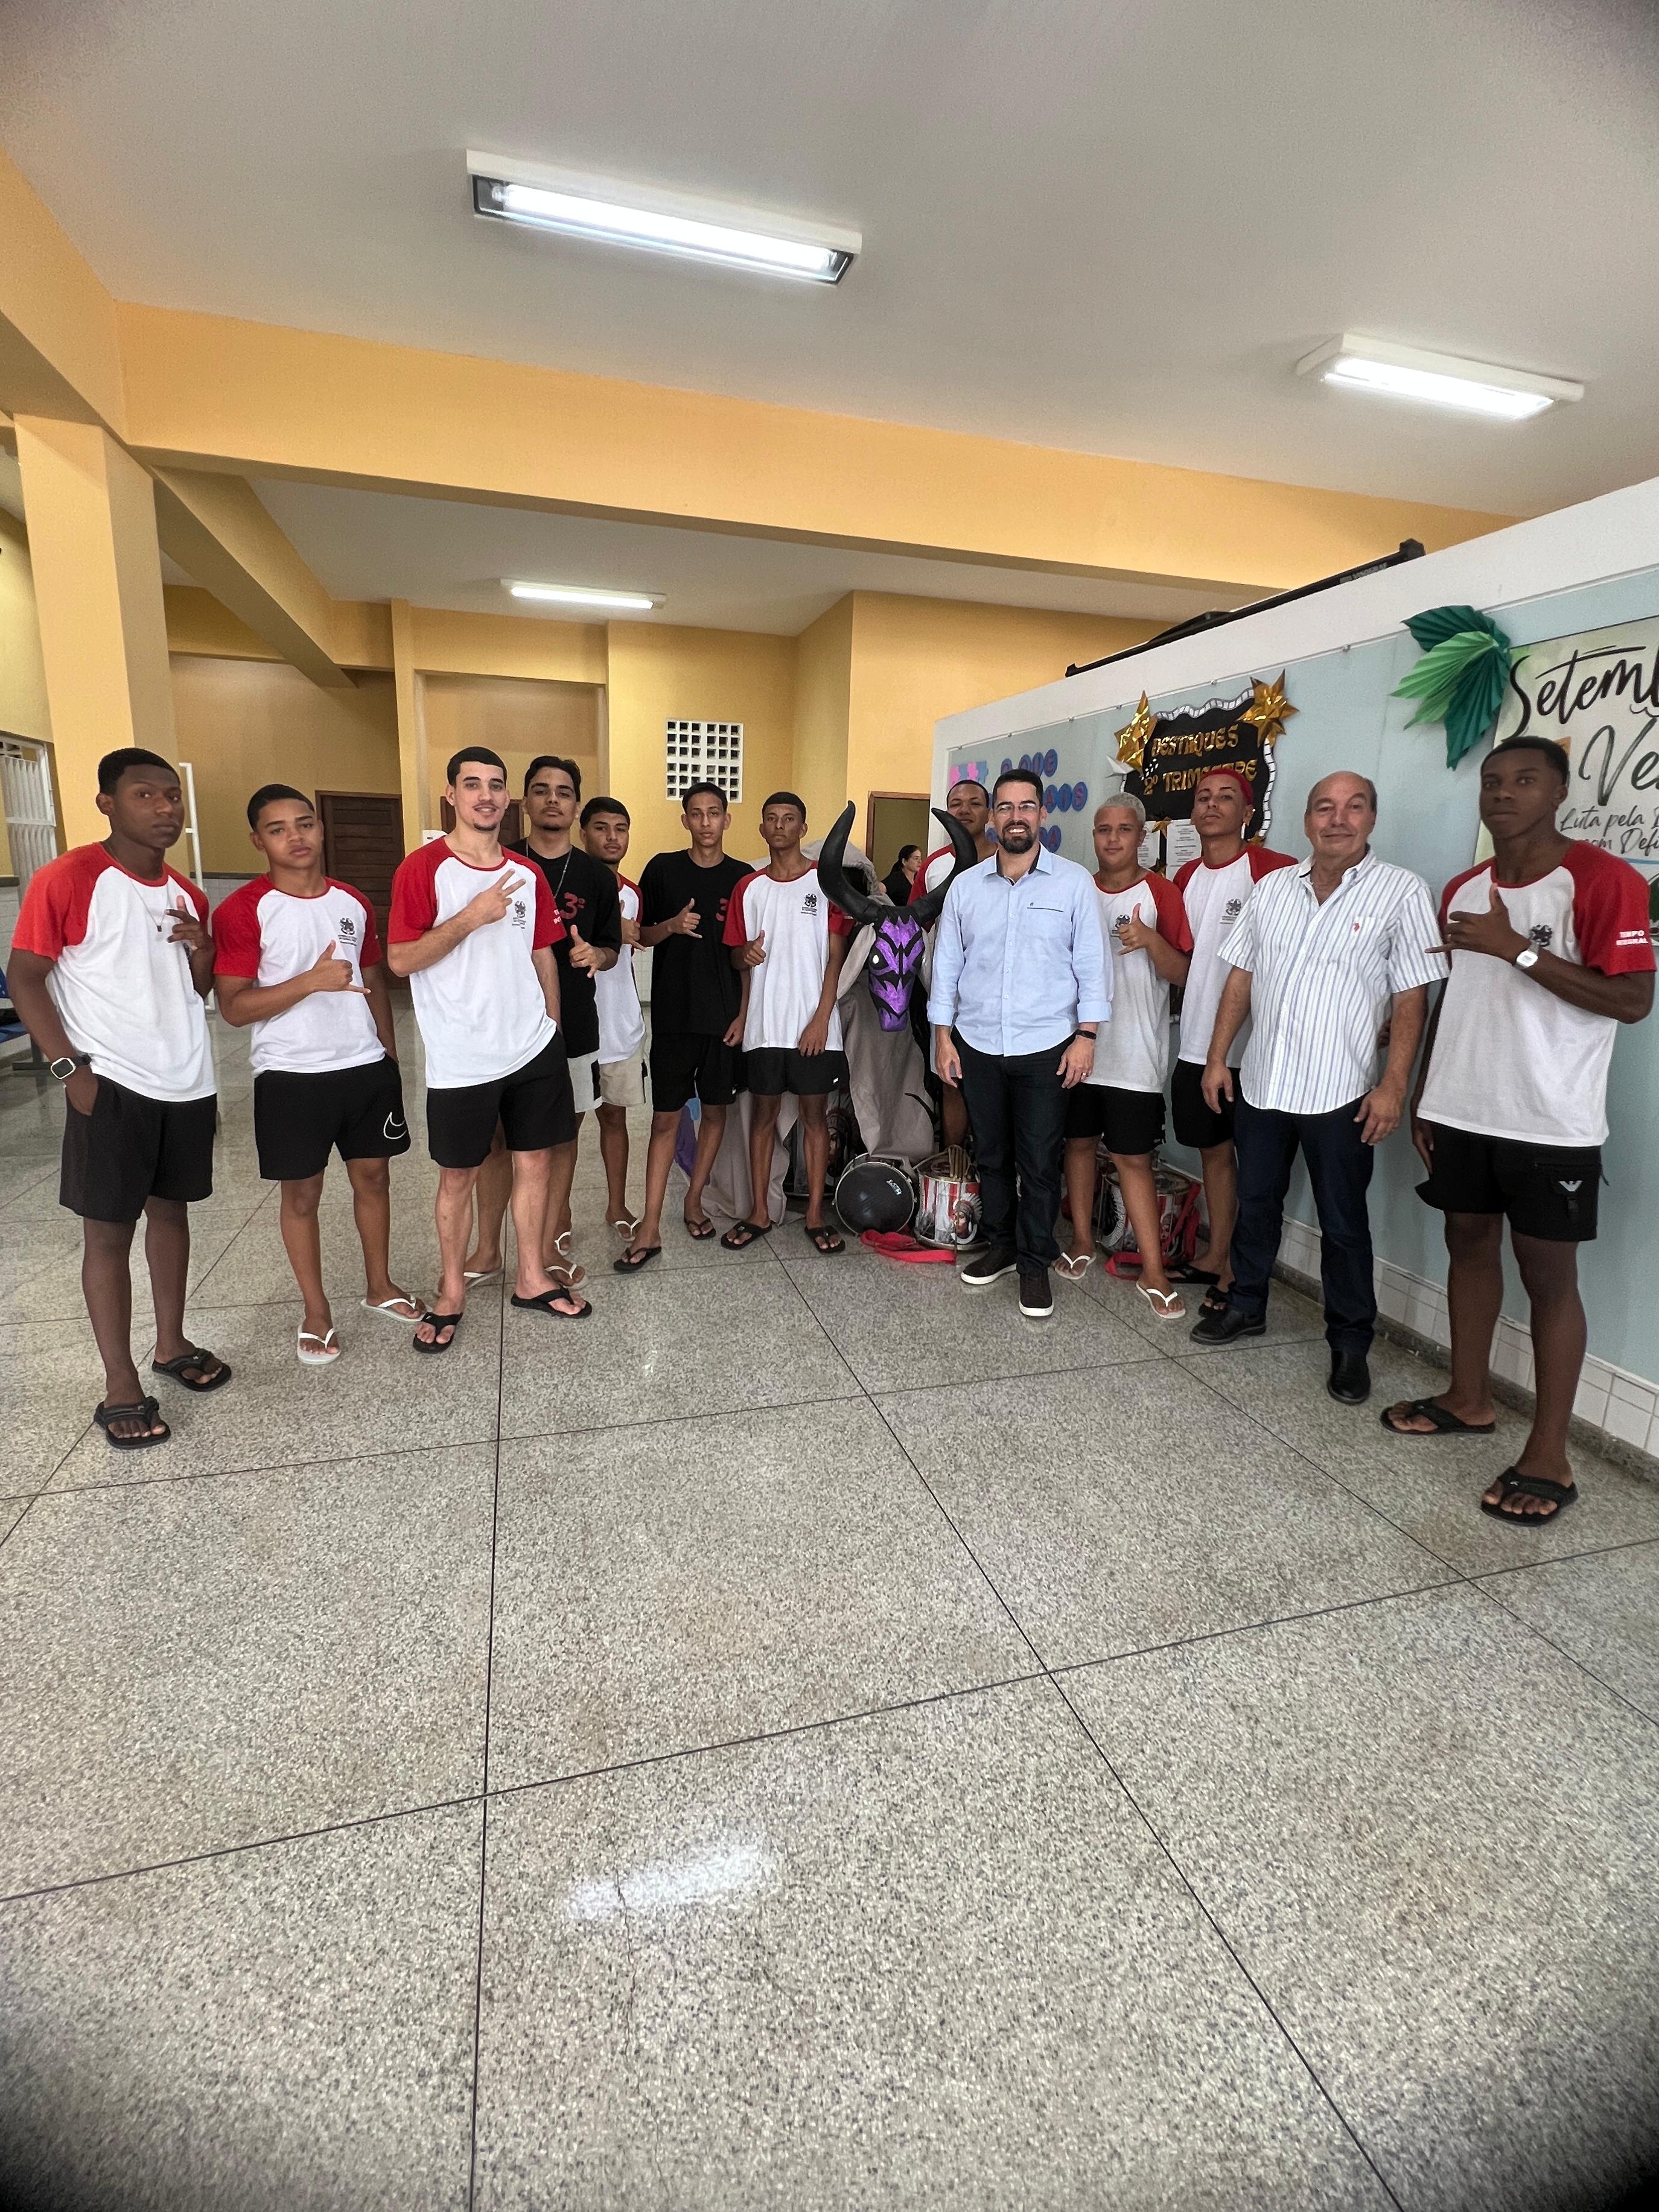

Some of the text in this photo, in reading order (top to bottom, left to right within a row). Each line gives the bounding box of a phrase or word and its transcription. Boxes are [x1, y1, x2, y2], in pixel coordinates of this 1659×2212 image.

[1151, 724, 1238, 757] DESTAQUES
[1578, 717, 1659, 806] Ve
[1560, 806, 1600, 831] Luta
[1603, 805, 1645, 837] pela
